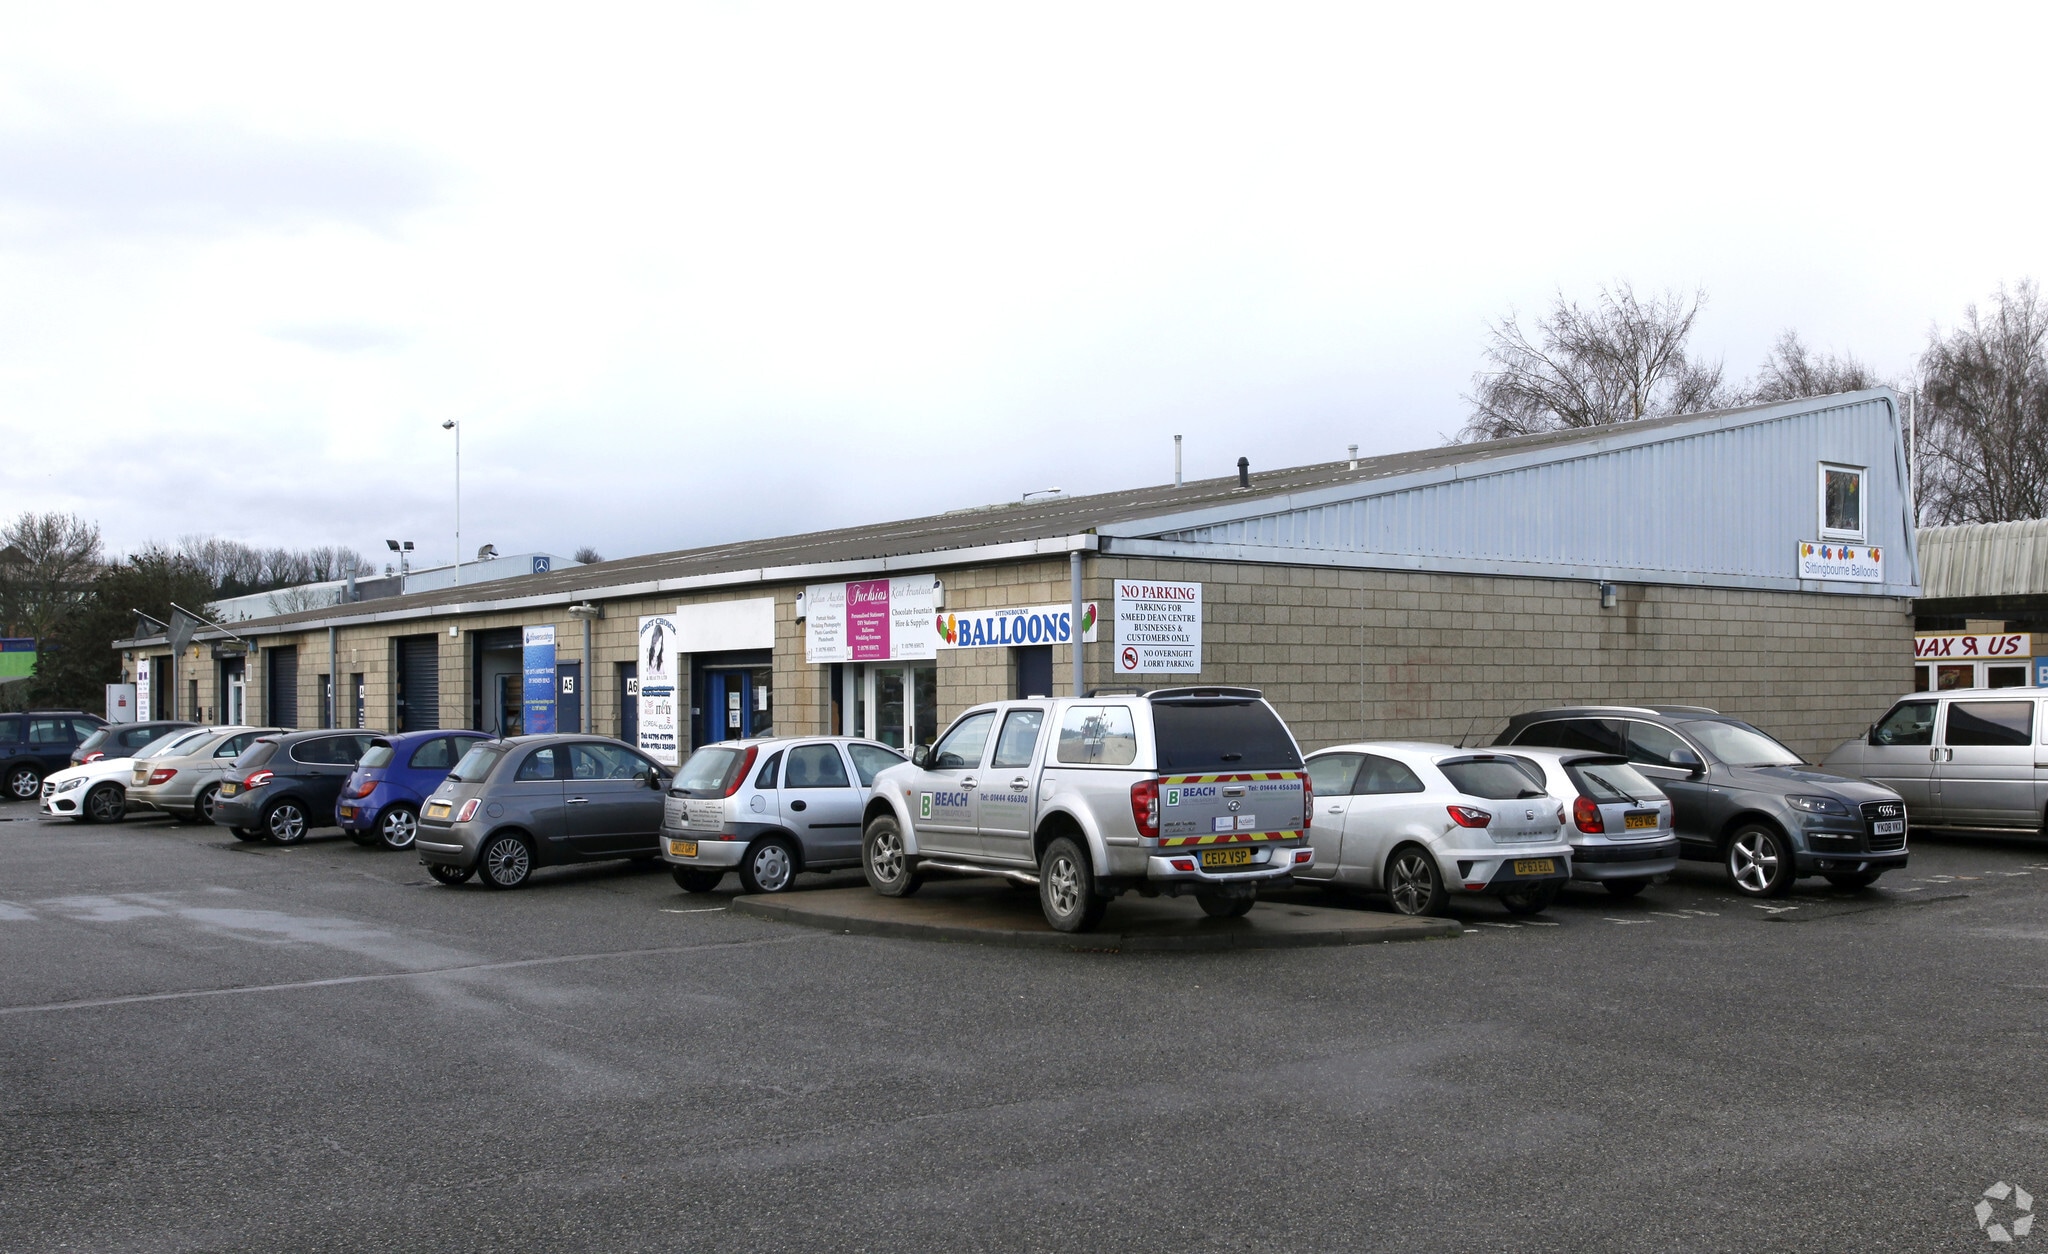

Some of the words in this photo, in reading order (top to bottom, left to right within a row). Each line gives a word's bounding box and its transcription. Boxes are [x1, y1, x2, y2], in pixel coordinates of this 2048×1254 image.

[1805, 562, 1850, 578] Sittingbourne
[1851, 564, 1878, 578] Balloons
[847, 584, 888, 606] Fuchsias
[1121, 585, 1139, 598] NO
[1142, 586, 1195, 600] PARKING
[892, 608, 912, 616] Chocolate
[995, 608, 1029, 617] SITTINGBOURNE
[1136, 603, 1166, 612] PARKING
[1168, 604, 1182, 612] FOR
[910, 618, 930, 628] Supplies
[1121, 613, 1146, 621] SMEED
[1147, 614, 1167, 622] DEAN
[958, 612, 1070, 646] BALLOONS
[1134, 624, 1176, 632] BUSINESSES
[1126, 634, 1170, 642] CUSTOMERS
[1988, 635, 2021, 655] US
[564, 679, 572, 691] A5
[628, 680, 637, 693] A6
[1169, 791, 1178, 804] B
[1183, 787, 1216, 797] BEACH
[935, 792, 968, 807] BEACH
[1007, 795, 1028, 803] 456308
[922, 795, 930, 816] B
[1626, 816, 1643, 828] S729
[1876, 823, 1891, 833] YK08
[1205, 853, 1226, 865] CE12
[1229, 851, 1247, 863] VSP
[1518, 862, 1537, 872] GF63
[1539, 862, 1552, 872] EZL
